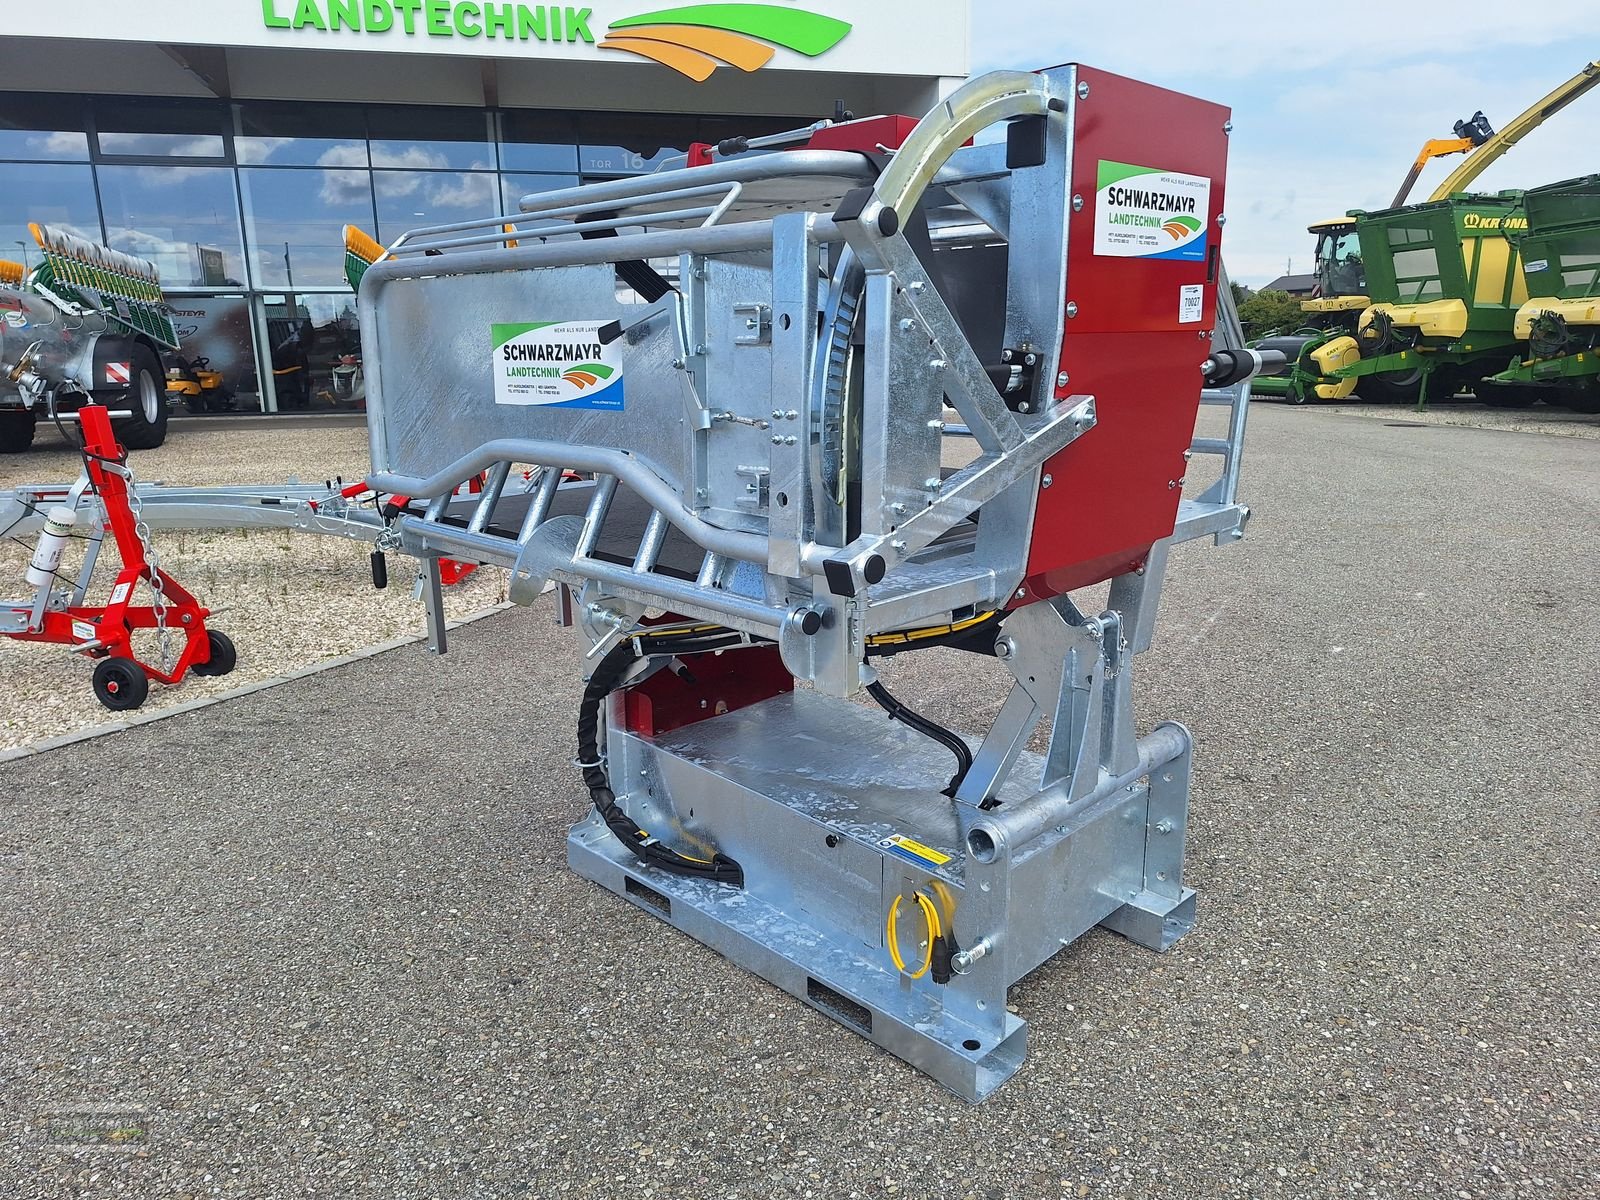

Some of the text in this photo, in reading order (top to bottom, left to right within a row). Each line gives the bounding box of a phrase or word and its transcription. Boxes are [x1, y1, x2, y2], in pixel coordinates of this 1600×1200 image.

[261, 0, 595, 43] LANDTECHNIK
[590, 152, 644, 169] TOR 16
[1108, 186, 1195, 213] SCHWARZMAYR
[1108, 212, 1161, 228] LANDTECHNIK
[503, 343, 602, 361] SCHWARZMAYR
[506, 366, 560, 378] LANDTECHNIK
